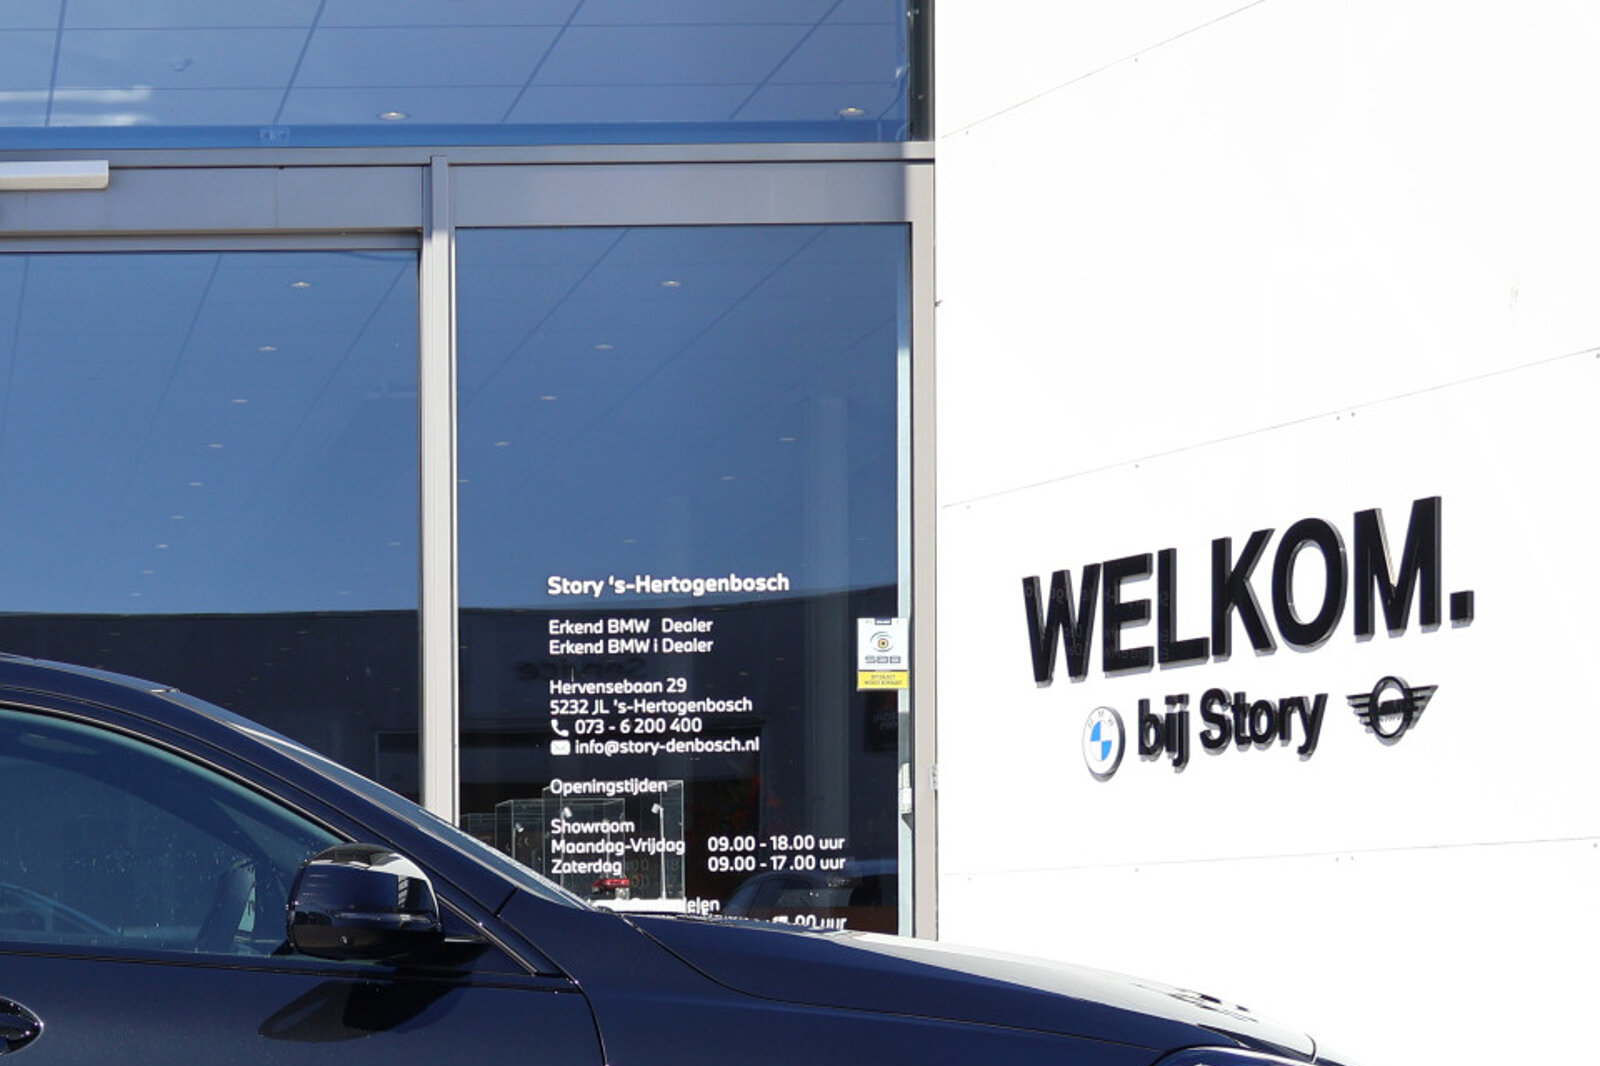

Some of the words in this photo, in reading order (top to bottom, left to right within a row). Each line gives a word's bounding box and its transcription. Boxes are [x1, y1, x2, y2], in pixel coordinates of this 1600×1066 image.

[547, 574, 605, 598] Story
[608, 572, 790, 597] 's-Hertogenbosch
[1022, 495, 1475, 688] WELKOM.
[548, 619, 604, 635] Erkend
[607, 618, 651, 634] BMW
[661, 617, 714, 634] Dealer
[549, 639, 604, 655] Erkend
[607, 638, 651, 654] BMW
[653, 637, 658, 653] i
[661, 637, 714, 654] Dealer
[549, 679, 664, 695] Hervensebaan
[666, 677, 688, 693] 29
[550, 699, 589, 716] 5232
[591, 699, 610, 716] JL
[613, 696, 753, 718] 's-Hertogenbosch
[574, 719, 605, 735] 073
[619, 718, 631, 734] 6
[634, 717, 666, 734] 200
[669, 717, 703, 733] 400
[1138, 693, 1191, 774] bij
[1199, 687, 1330, 762] Story
[575, 736, 760, 756] info@story-denbosch.nl
[550, 778, 668, 797] Openingstijden
[550, 818, 635, 834] Showroom
[551, 837, 686, 857] Maandag-Vrijdag
[707, 836, 756, 852] 09.00
[769, 835, 816, 851] 18.00
[818, 837, 846, 851] uur
[551, 857, 623, 876] Zaterdag
[707, 856, 756, 872] 09.00
[819, 857, 847, 871] uur
